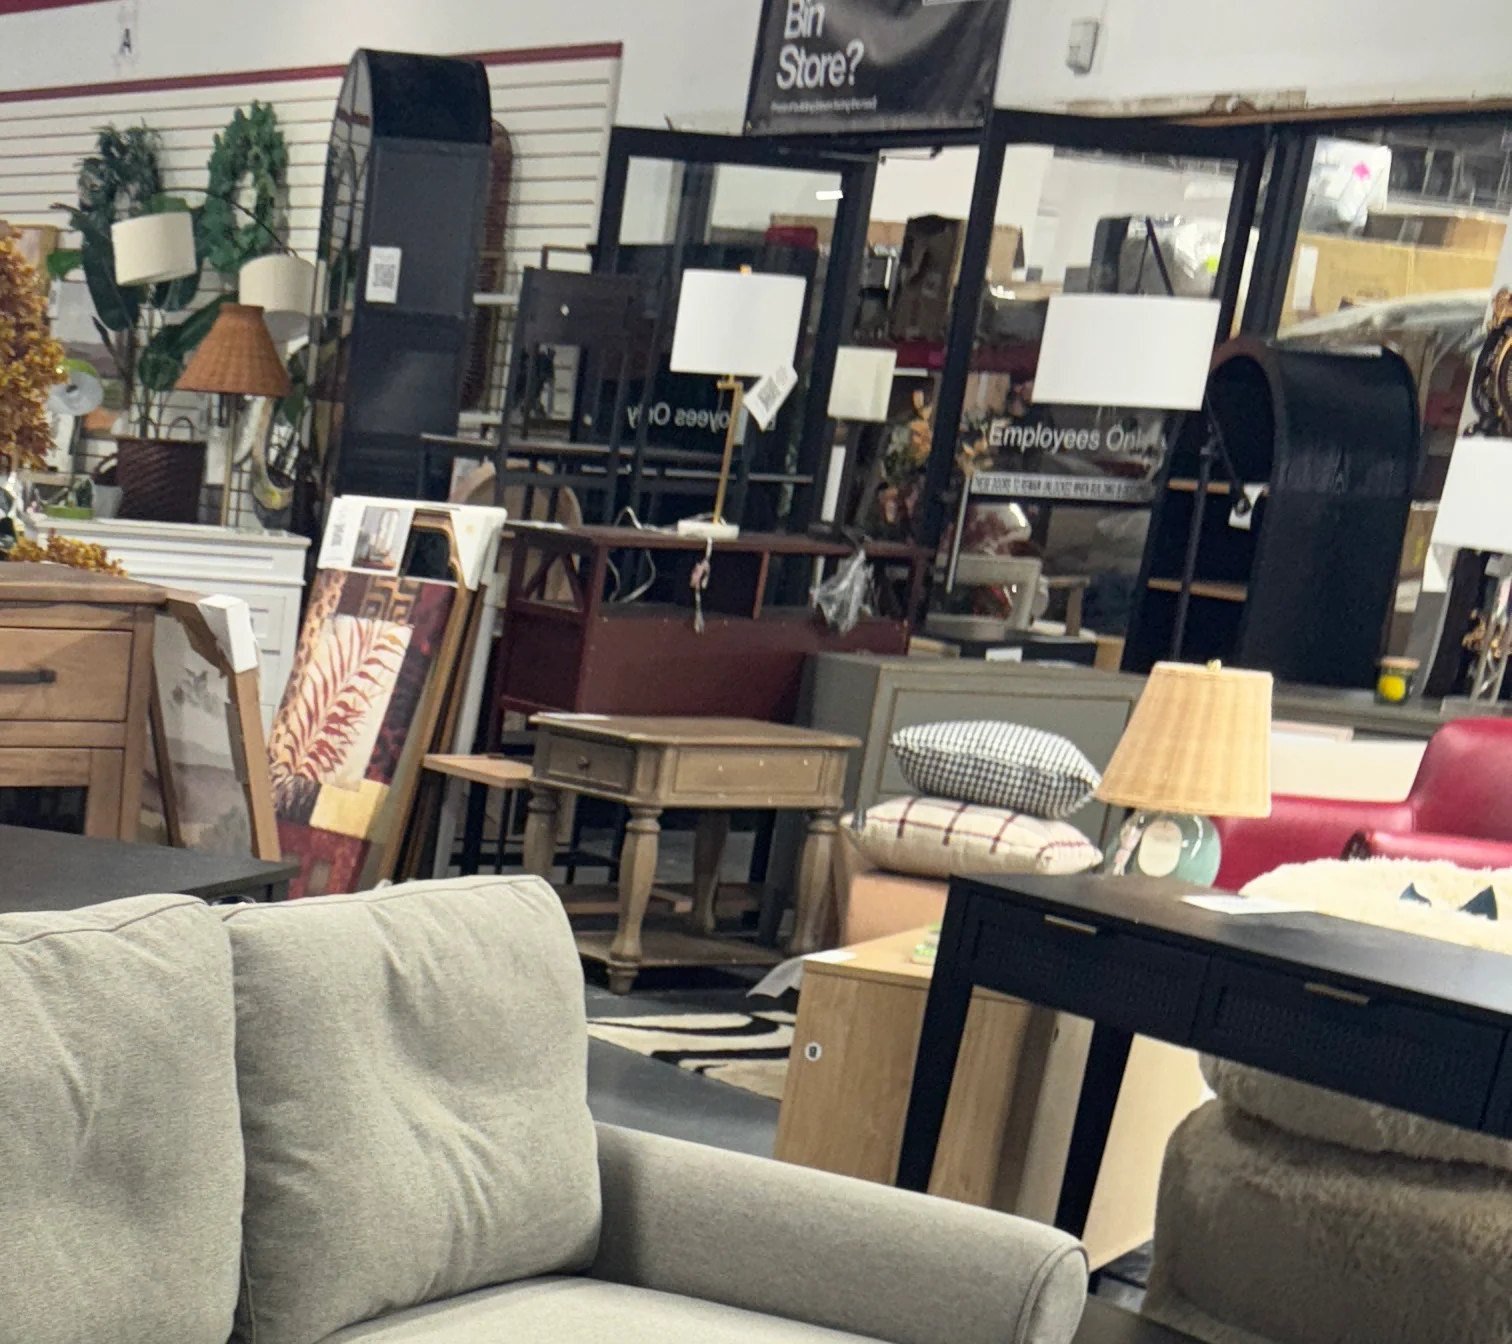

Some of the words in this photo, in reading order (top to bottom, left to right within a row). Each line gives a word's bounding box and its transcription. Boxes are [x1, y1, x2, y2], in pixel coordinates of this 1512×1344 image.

[784, 0, 826, 40] Bin
[776, 38, 865, 91] Store?
[989, 419, 1101, 455] Employees
